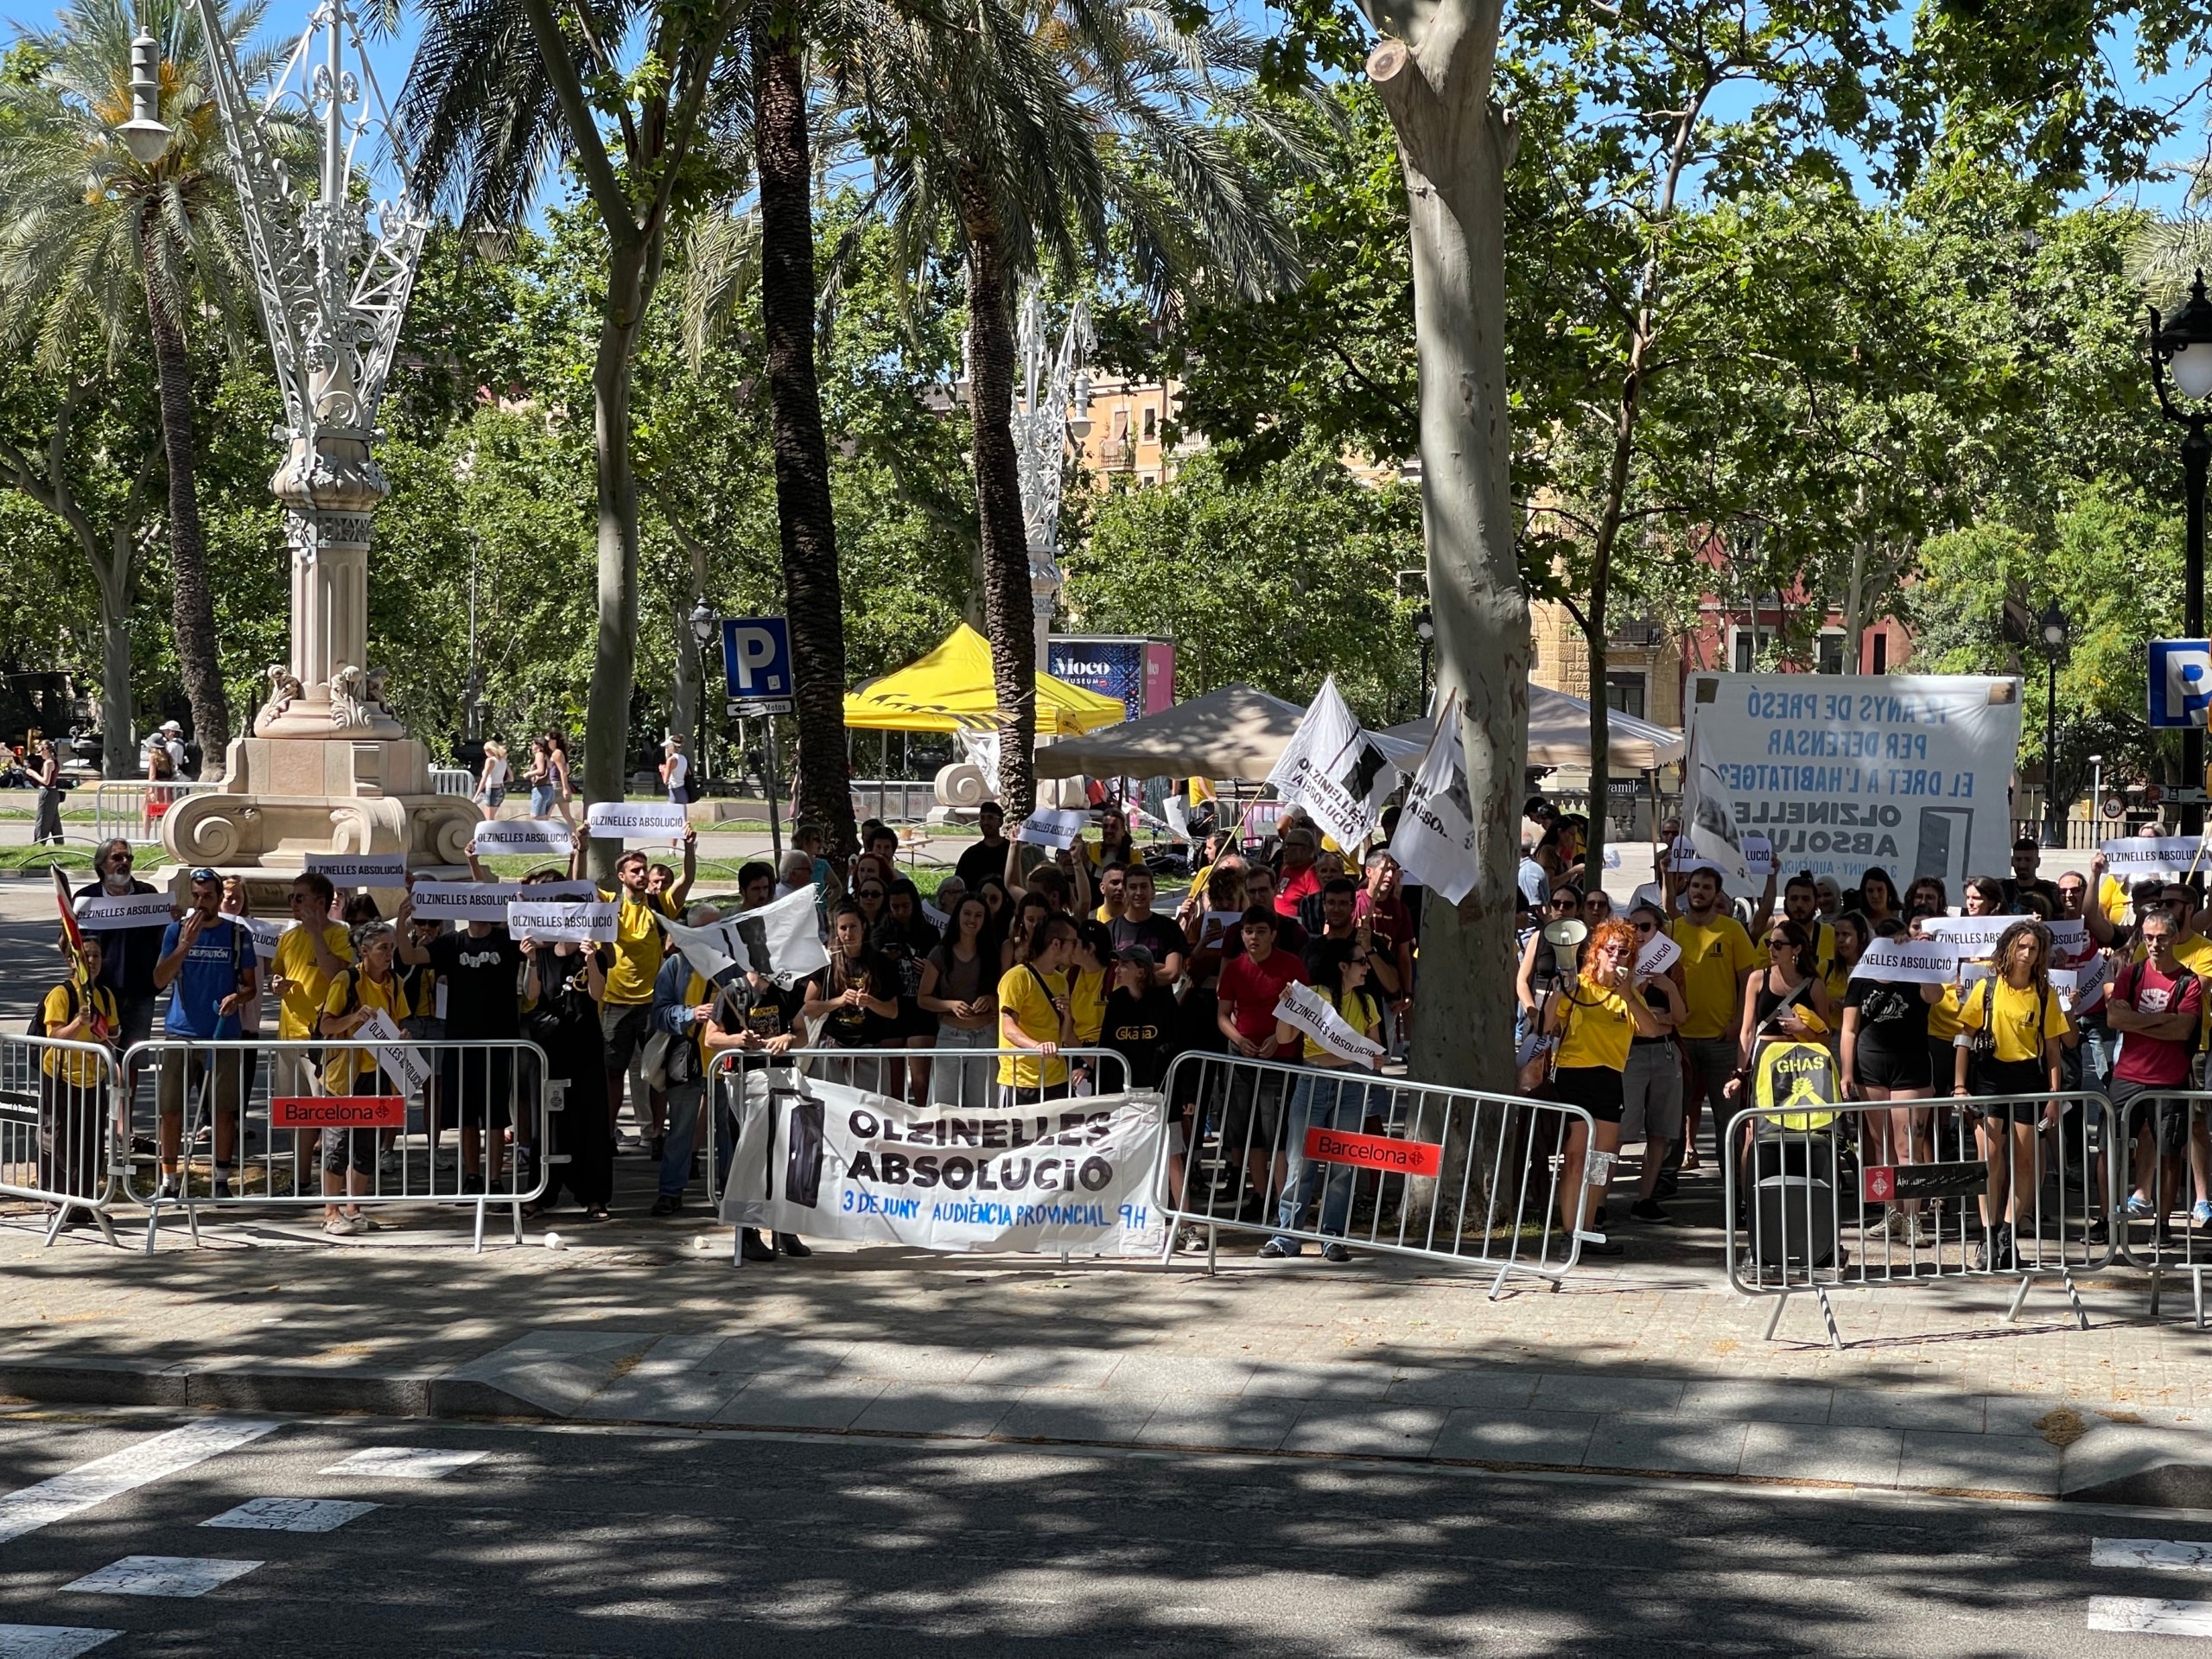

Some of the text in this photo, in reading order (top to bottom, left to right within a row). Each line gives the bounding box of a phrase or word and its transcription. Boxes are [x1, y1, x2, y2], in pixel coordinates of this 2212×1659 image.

[735, 626, 776, 689] P
[1054, 658, 1110, 676] Moco
[2166, 650, 2212, 717] P
[590, 815, 683, 828] OLZINELLES ABSOLUCIÓ
[477, 830, 569, 843] OLZINELLES ABSOLUCIÓ
[2106, 851, 2157, 863] OLZINELLES
[358, 863, 404, 875] ABSOLUCIÓ
[416, 893, 467, 906] OLZINELLES
[469, 892, 518, 906] ABSOLUCIÓ
[77, 902, 171, 920] OLZINELLES ABSOLUCIÓ
[512, 915, 613, 929] OLZINELLES ABSOLUCIÓ
[1636, 942, 1672, 976] BSOLUCIÓ
[1899, 956, 1952, 970] ABSOLUCIÓ
[1284, 997, 1330, 1035] OLZINELLES
[1777, 1056, 1825, 1074] GHAS
[285, 1103, 373, 1121] Barcelona
[849, 1109, 1113, 1147] OLZINELLES
[1318, 1136, 1407, 1165] Barcelona
[846, 1147, 1114, 1192] ABSOLUCIÓ
[842, 1190, 1147, 1230] 3 DE JUNY AUDIÈNCIA PROVINCIAL 9H
